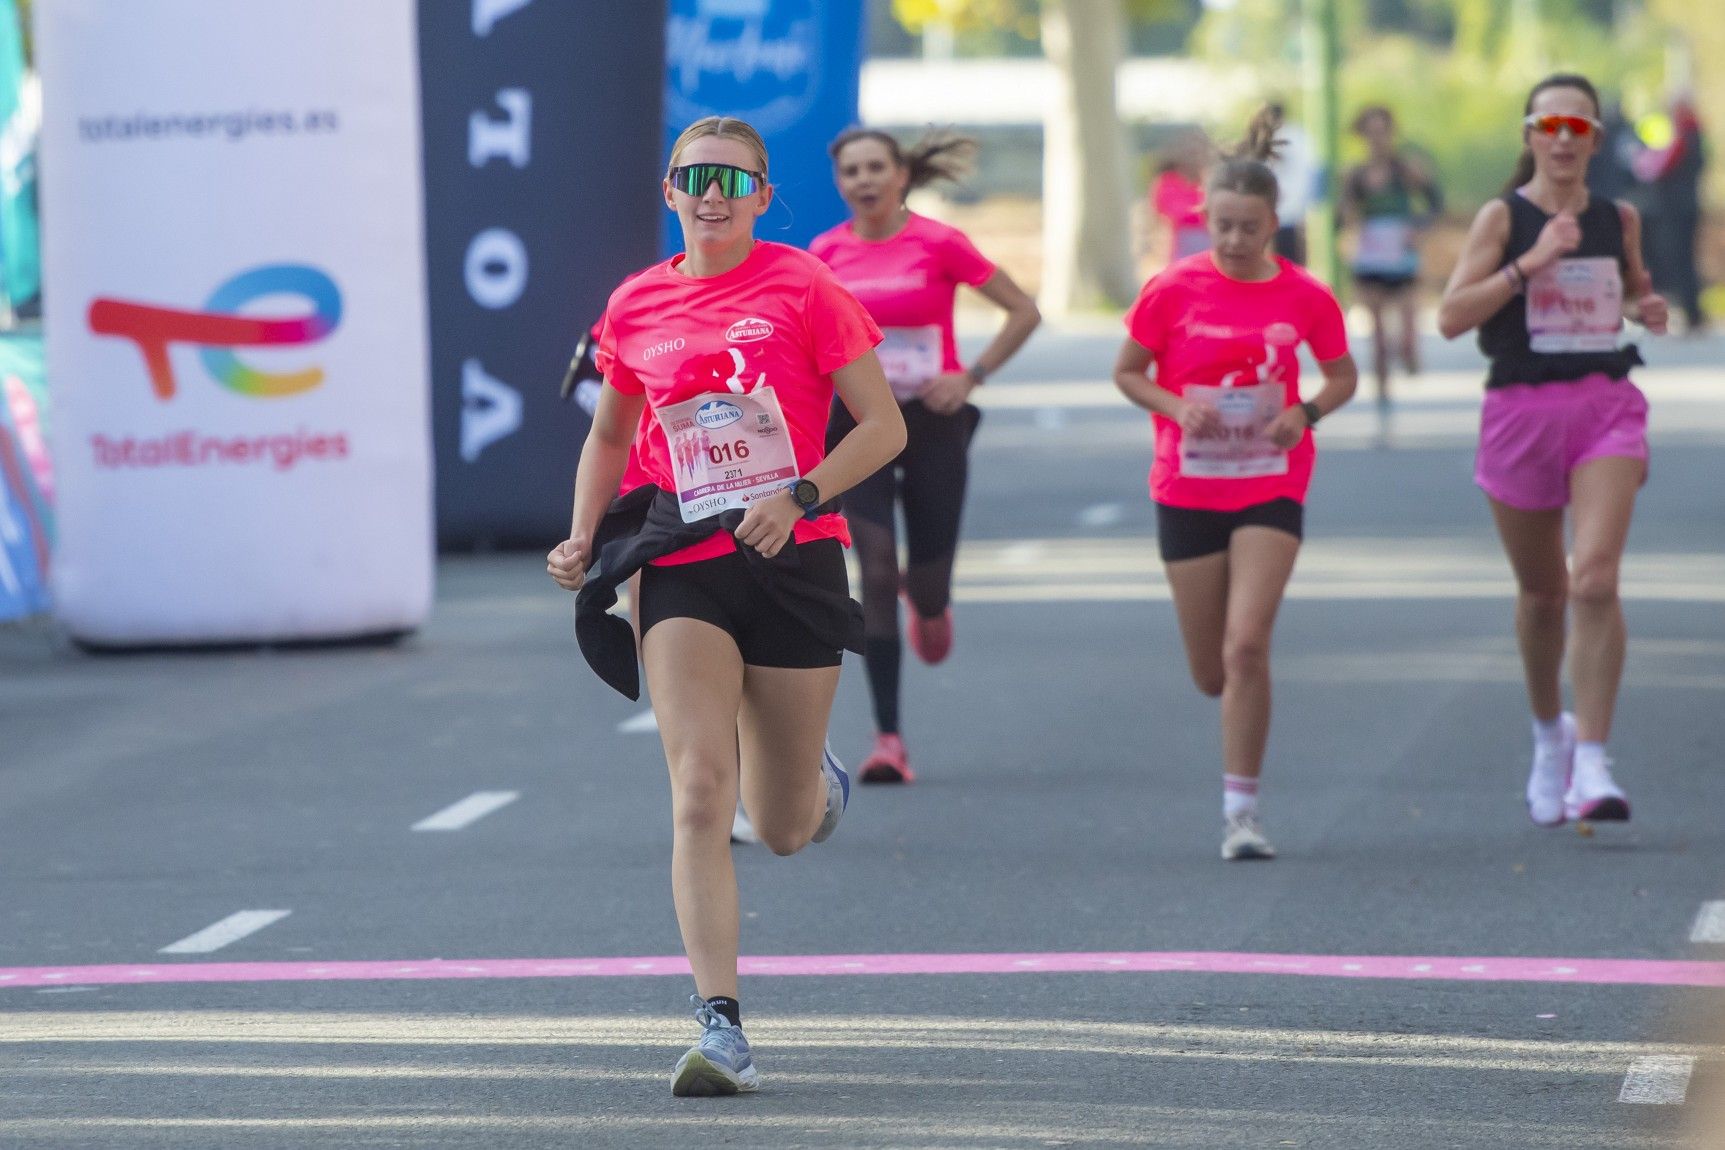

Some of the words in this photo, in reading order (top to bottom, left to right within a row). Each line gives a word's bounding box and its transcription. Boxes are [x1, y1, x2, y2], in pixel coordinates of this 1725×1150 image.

[643, 337, 686, 361] OYSHO
[699, 410, 740, 424] ASTURIANA
[89, 428, 350, 471] TotalEnergies
[708, 440, 750, 465] 016
[716, 483, 725, 491] DE
[755, 472, 779, 484] SEVILLA
[724, 468, 743, 480] 2371
[692, 496, 727, 513] OYSHO
